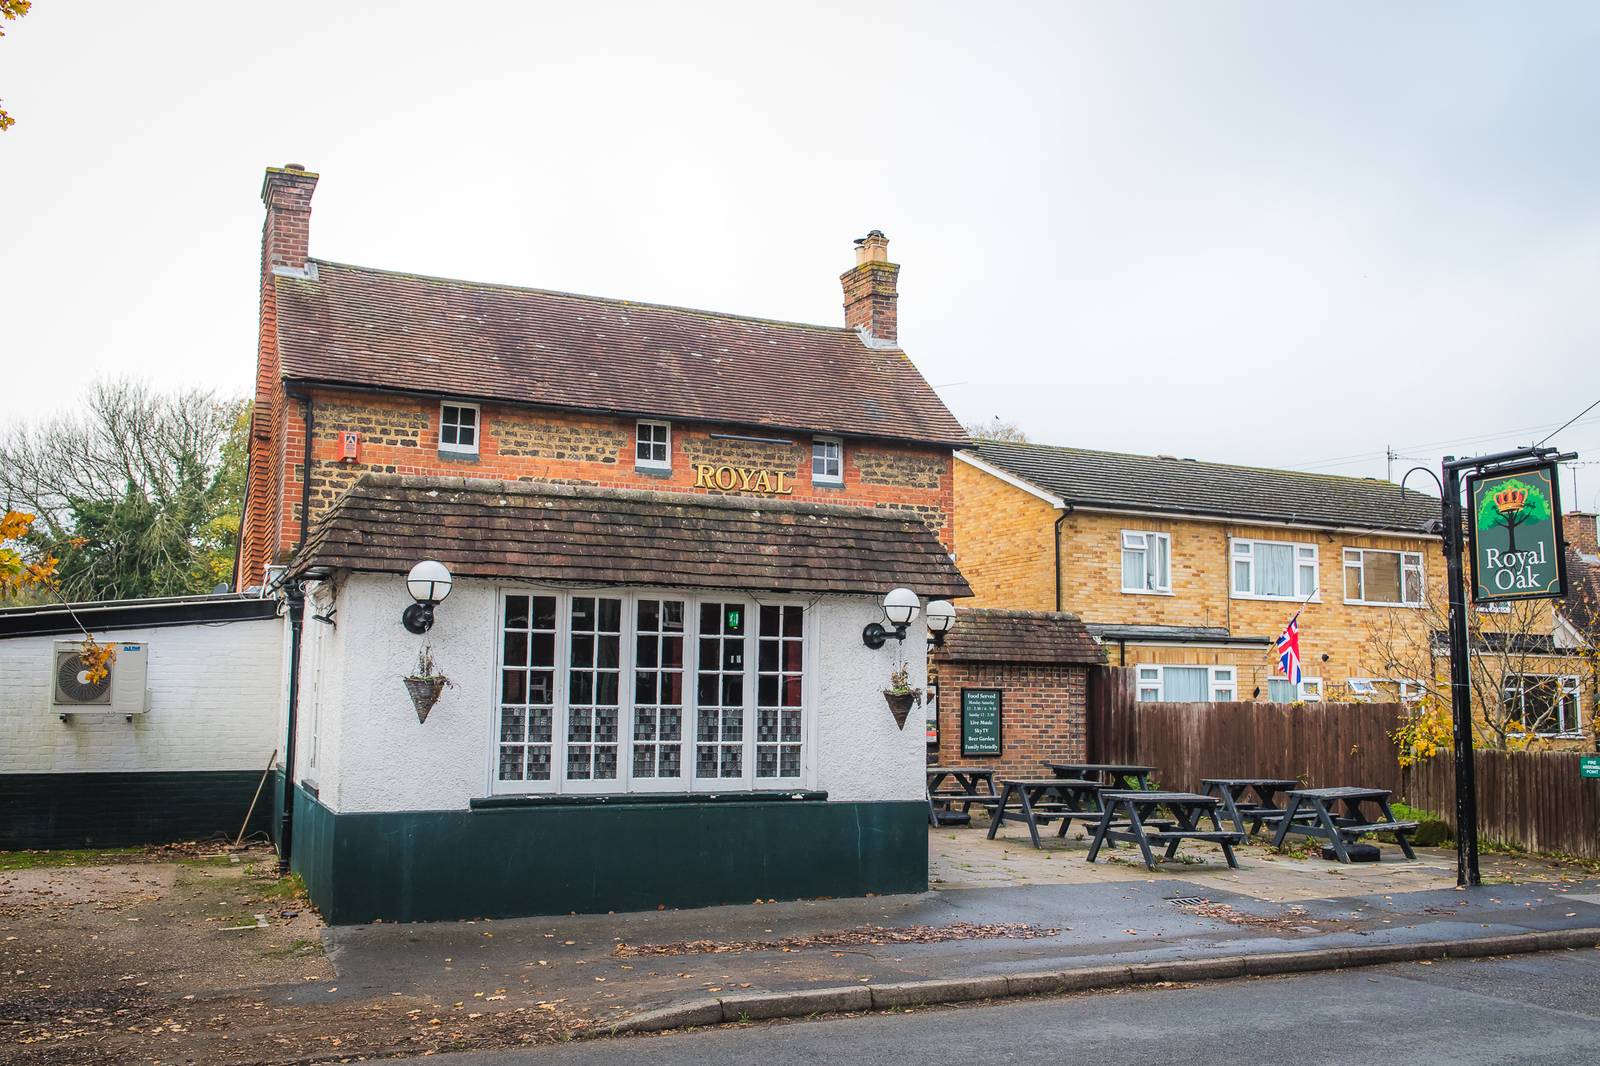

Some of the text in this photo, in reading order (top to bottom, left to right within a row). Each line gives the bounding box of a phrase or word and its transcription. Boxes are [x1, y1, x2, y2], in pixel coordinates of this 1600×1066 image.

[694, 464, 793, 494] ROYAL
[1486, 541, 1547, 575] Royal
[1495, 566, 1541, 590] Oak
